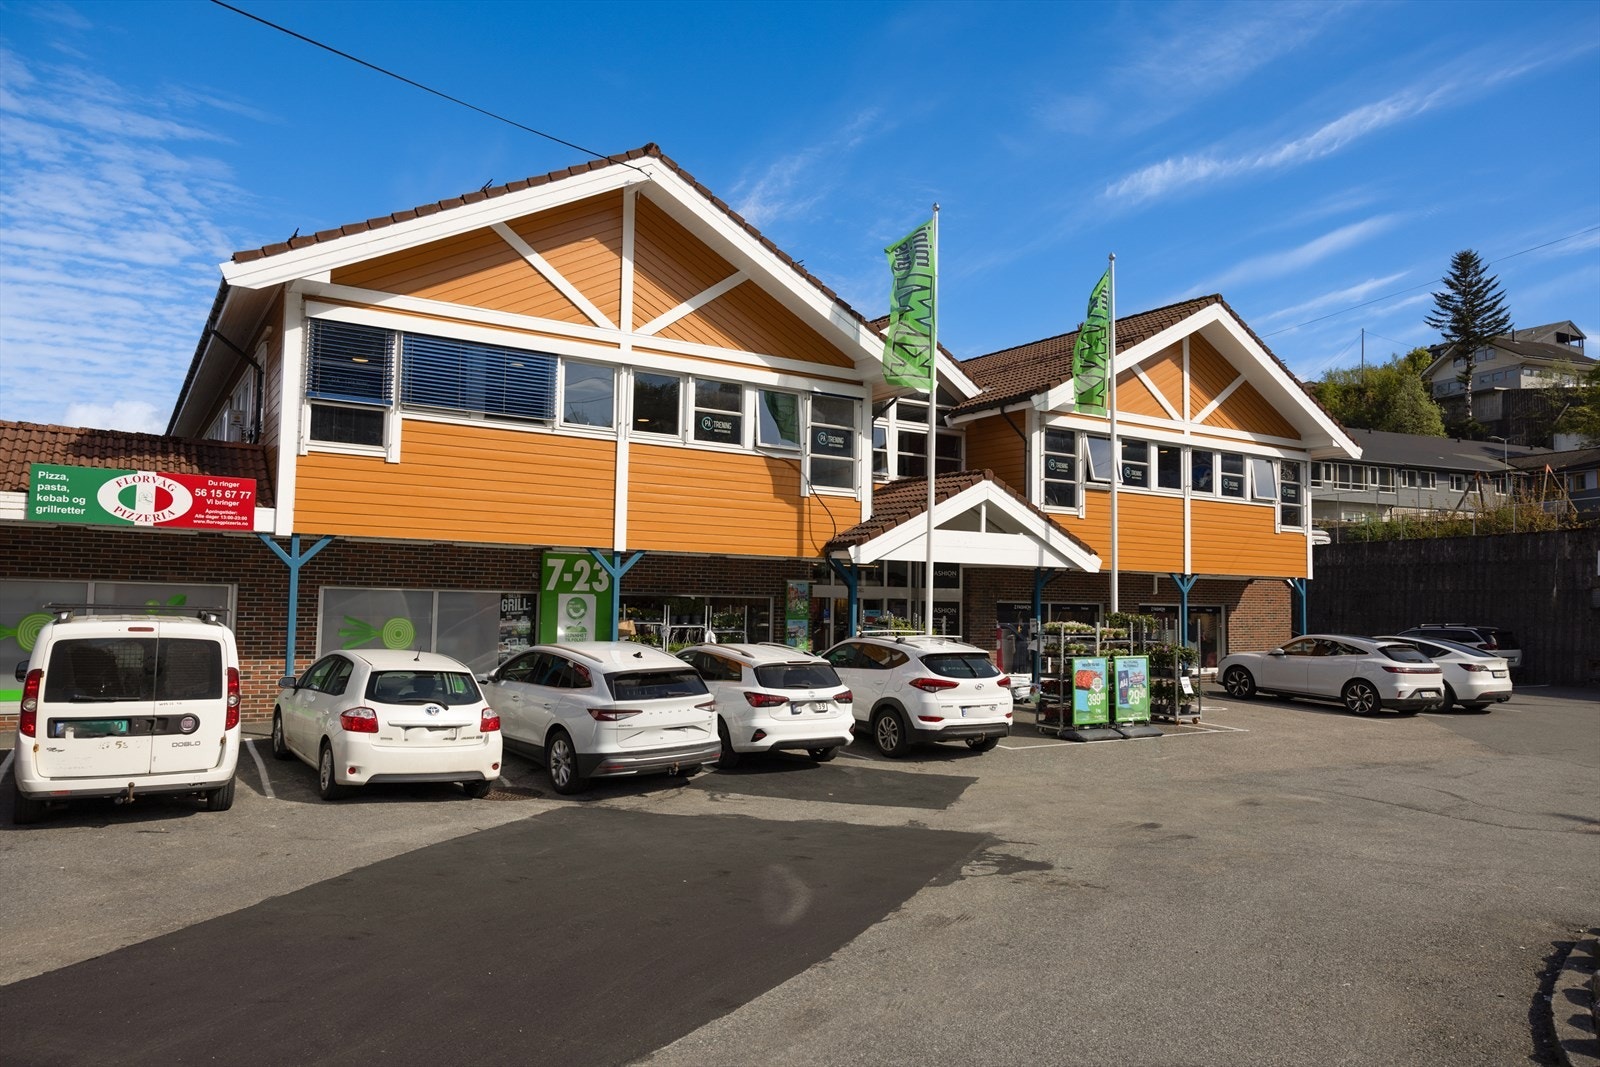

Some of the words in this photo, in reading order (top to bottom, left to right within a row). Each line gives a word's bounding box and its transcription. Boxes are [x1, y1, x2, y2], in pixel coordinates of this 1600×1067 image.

[713, 420, 732, 430] TRENING
[38, 471, 69, 482] Pizza,
[37, 484, 70, 493] pasta,
[194, 488, 207, 497] 56
[210, 489, 222, 498] 15
[224, 490, 237, 499] 67
[239, 491, 252, 500] 77
[36, 493, 70, 503] kebab
[72, 497, 86, 506] og
[35, 505, 86, 515] grillretter
[113, 506, 176, 523] PIZZERIA
[546, 559, 609, 592] 7-23
[171, 740, 201, 748] DOBLO
